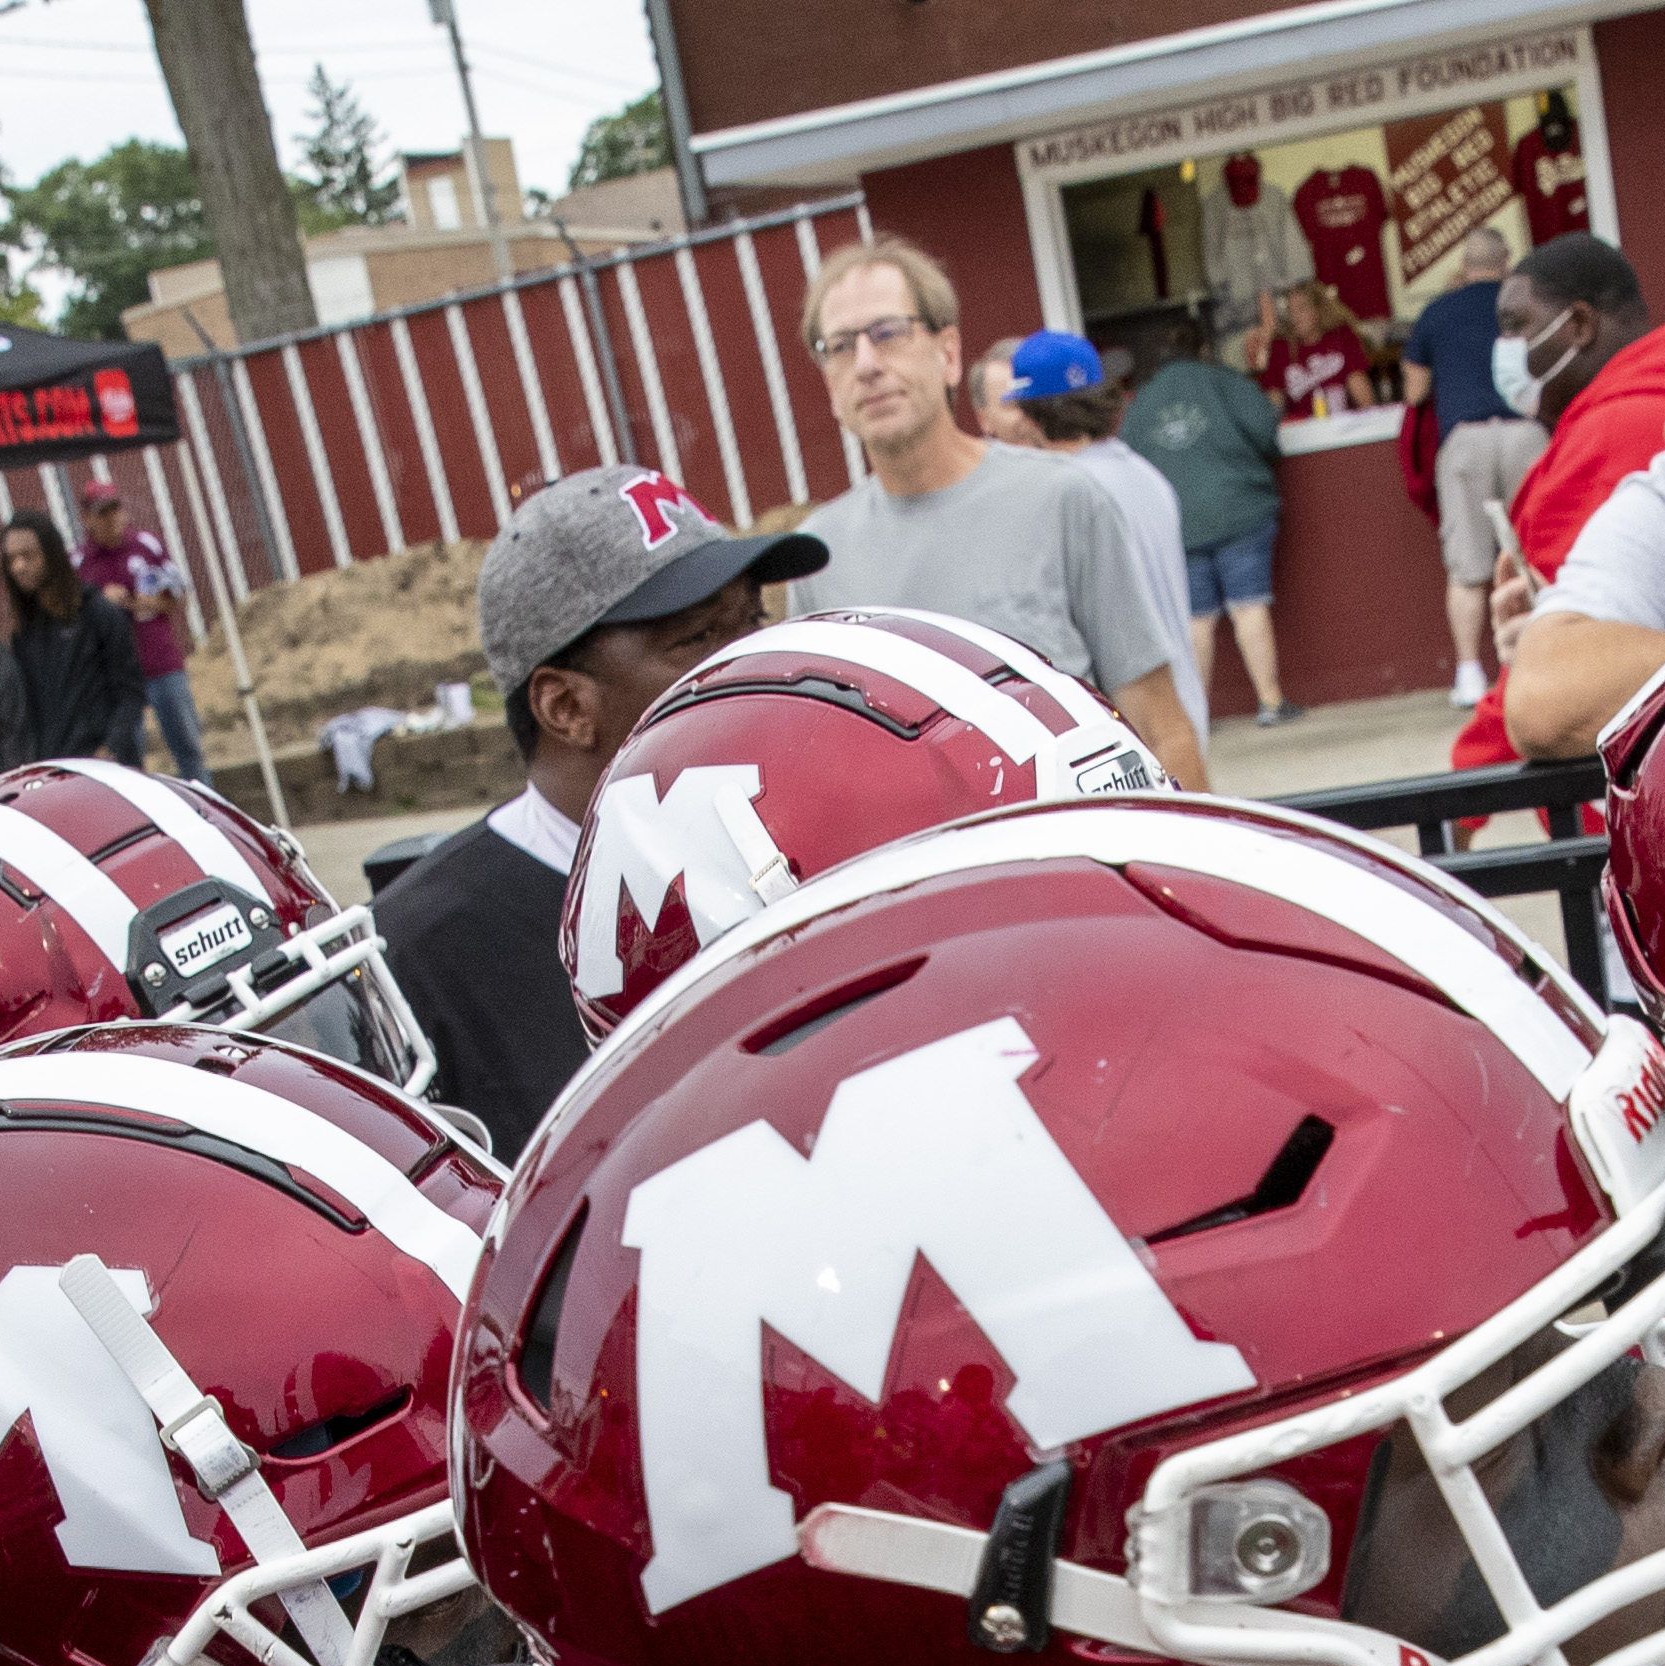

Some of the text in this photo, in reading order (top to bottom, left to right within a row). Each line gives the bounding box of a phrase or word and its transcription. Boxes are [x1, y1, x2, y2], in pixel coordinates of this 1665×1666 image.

[1328, 72, 1383, 107] RED
[618, 469, 720, 552] M
[574, 764, 767, 999] M
[175, 916, 244, 967] schutt
[620, 1015, 1259, 1617] M
